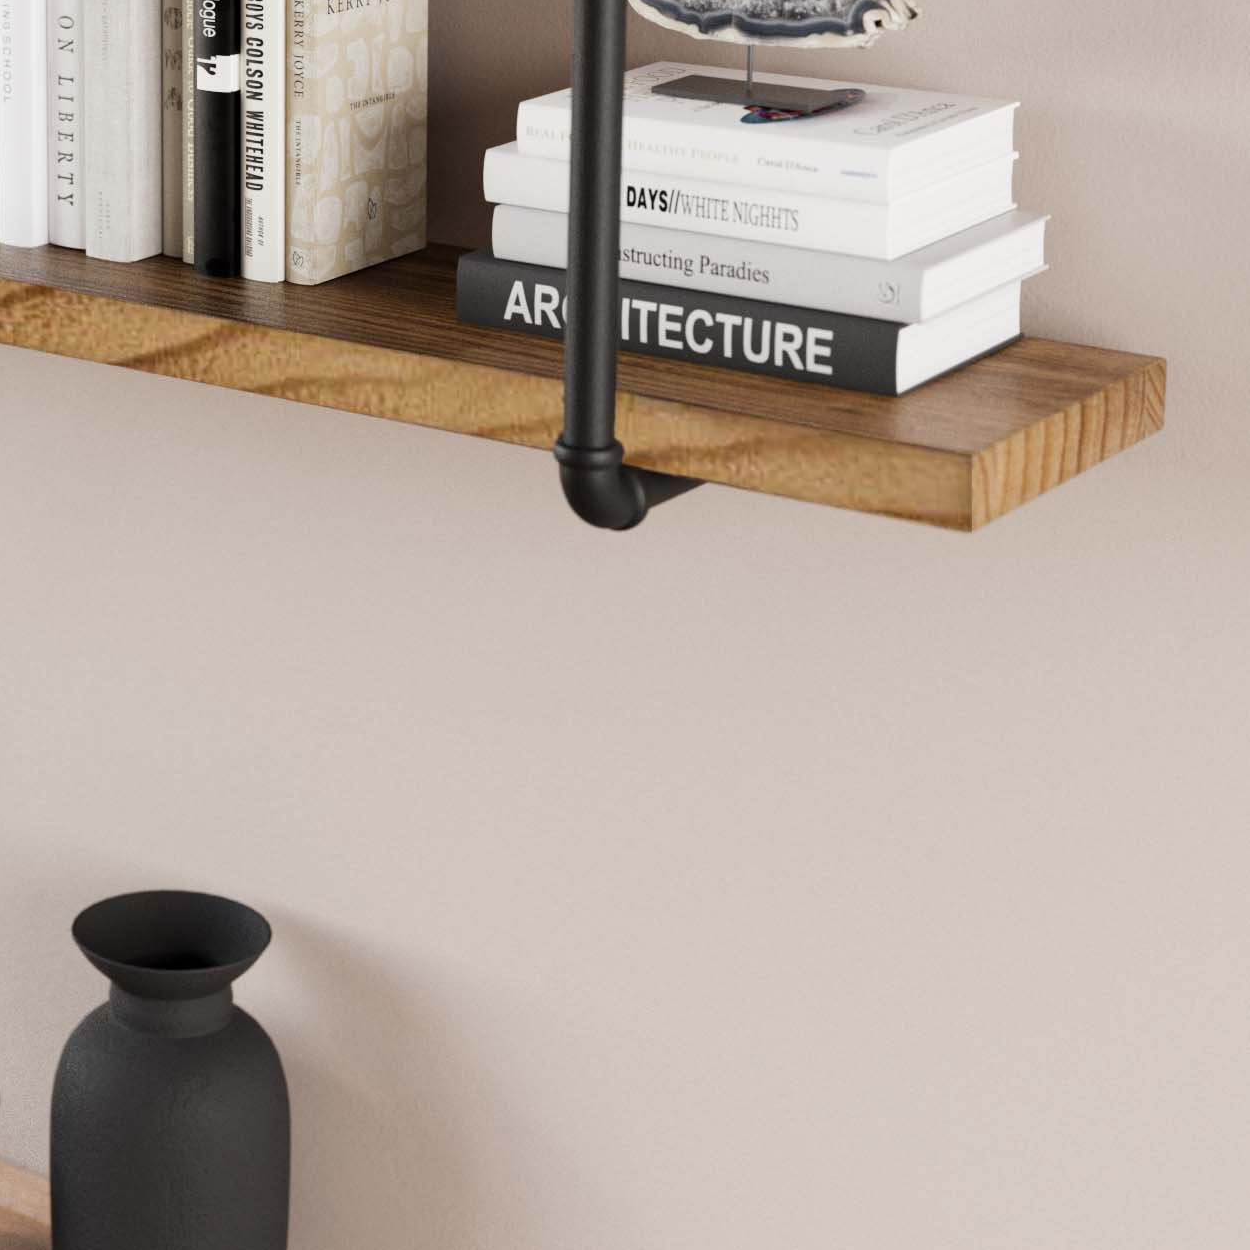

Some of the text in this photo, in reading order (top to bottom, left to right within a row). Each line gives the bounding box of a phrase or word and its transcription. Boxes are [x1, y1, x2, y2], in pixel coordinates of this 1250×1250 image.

[56, 15, 75, 54] ON
[246, 37, 264, 101] COLSON
[293, 0, 305, 99] KERRY JOYCE
[57, 75, 75, 207] LIBERTY
[246, 110, 264, 192] WHITEHEAD
[616, 247, 771, 284] structing Paradies
[504, 280, 834, 375] ARITECTURE
